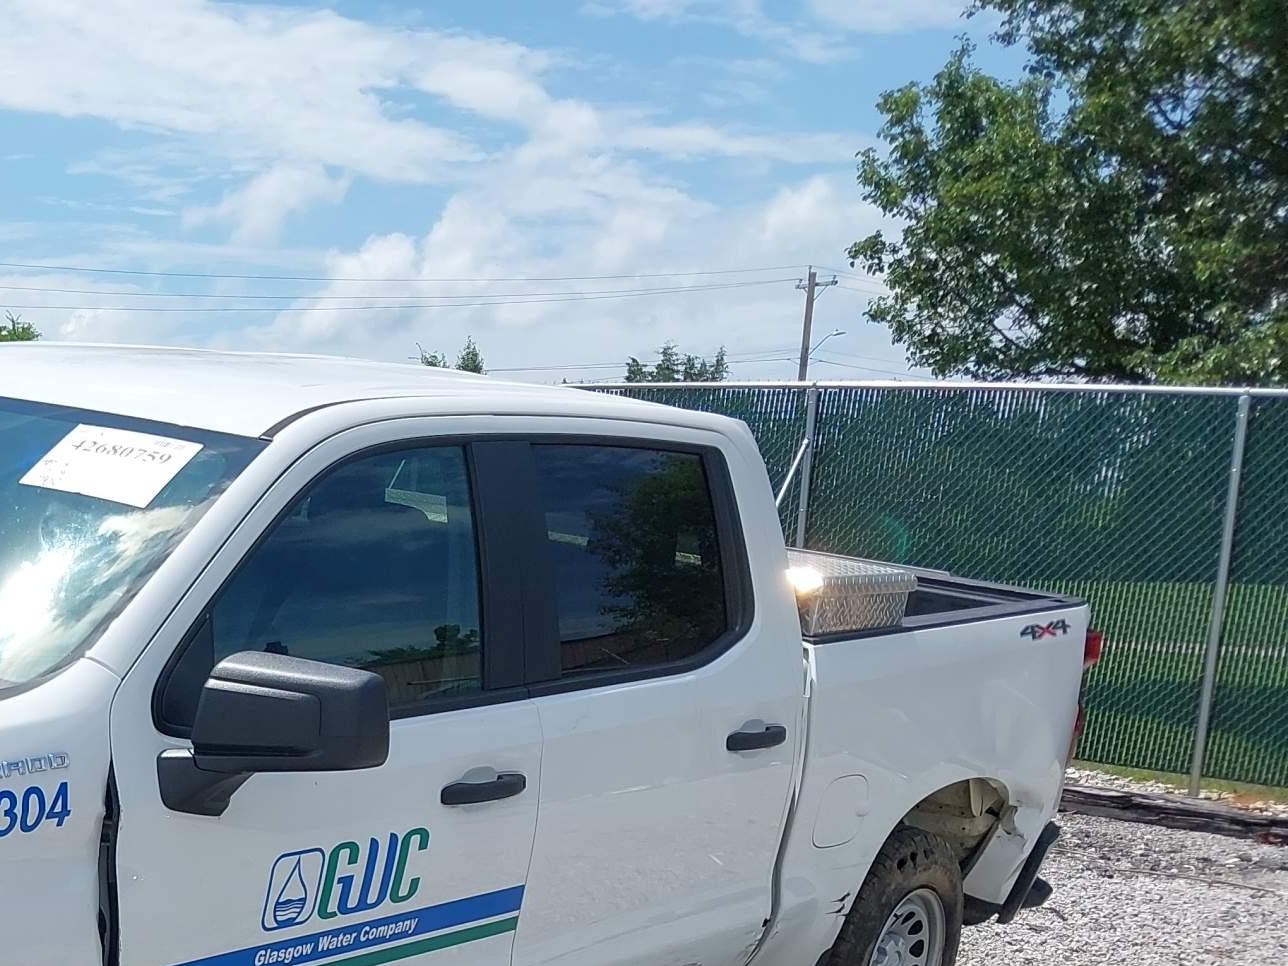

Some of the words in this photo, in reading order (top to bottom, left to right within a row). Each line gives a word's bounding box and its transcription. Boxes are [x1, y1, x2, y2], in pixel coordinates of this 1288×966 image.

[71, 439, 172, 465] 42680759
[317, 827, 430, 920] GWC
[254, 942, 315, 966] Glasgow
[317, 932, 358, 952] Water
[359, 917, 418, 942] Company
